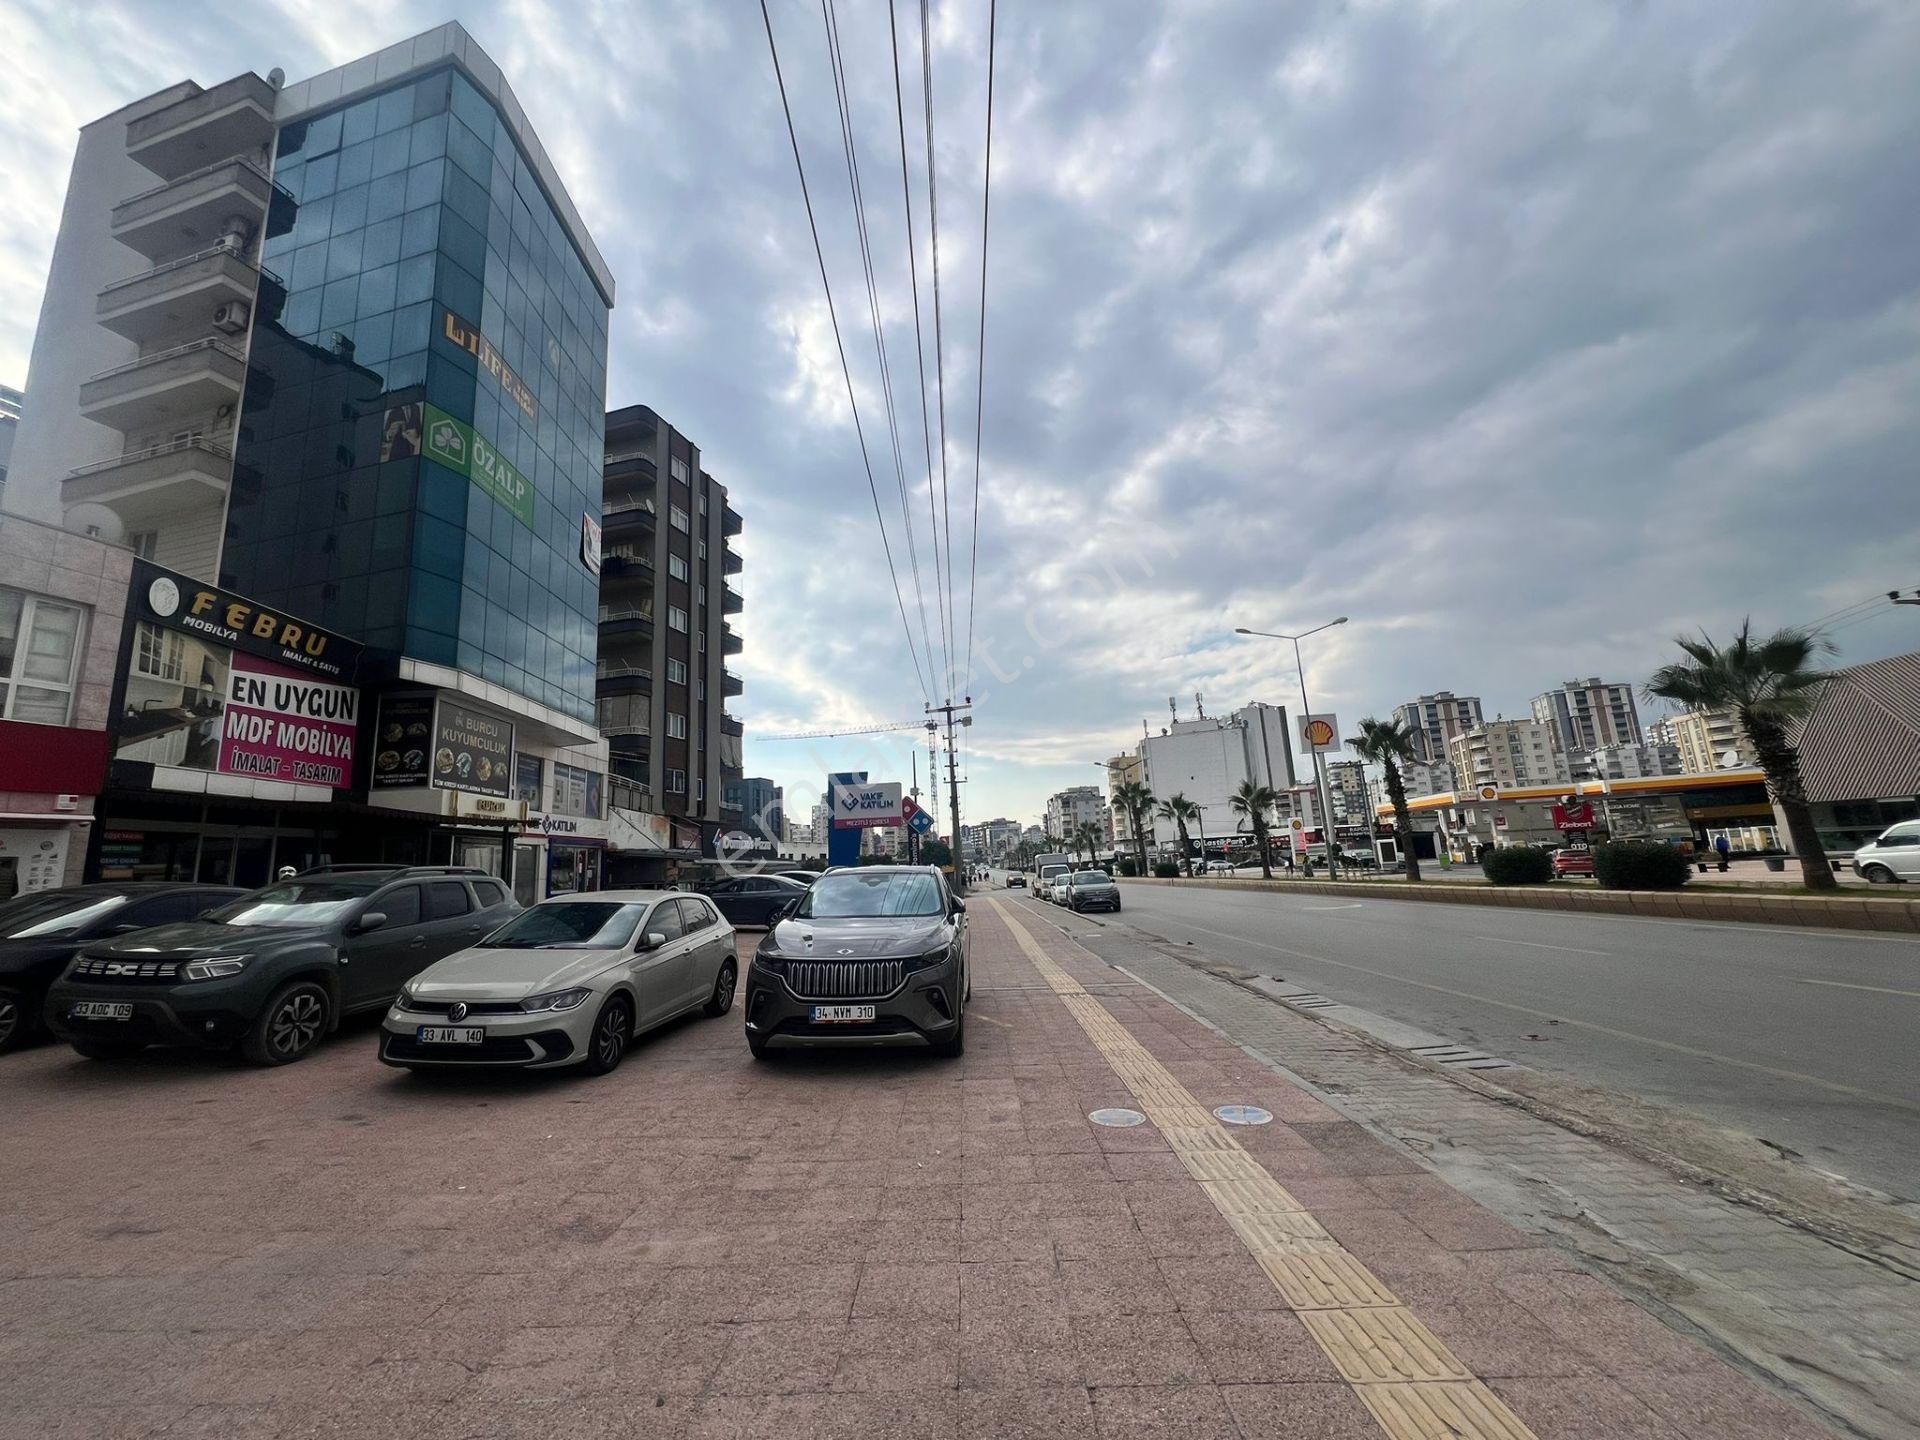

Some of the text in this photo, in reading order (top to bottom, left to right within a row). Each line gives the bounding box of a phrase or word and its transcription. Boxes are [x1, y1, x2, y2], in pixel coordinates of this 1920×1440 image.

[473, 436, 525, 501] ÖZALP
[191, 591, 328, 656] FEBRU
[282, 649, 313, 667] İMALAT
[318, 660, 341, 675] SATIŞ
[231, 676, 355, 720] EN UYGUN
[226, 711, 352, 760] MDF MOBİLYA
[466, 718, 498, 737] BURCU
[442, 727, 507, 755] KUYUMCULUK
[231, 747, 281, 776] İMALAT
[293, 761, 342, 784] TASARIM
[860, 792, 884, 800] VAKIF
[860, 800, 894, 809] KATILIM
[76, 1003, 89, 1015] 33
[113, 1005, 131, 1016] 109
[816, 1006, 873, 1019] 34 NVM 310
[423, 1029, 482, 1042] 33 AVL 140
